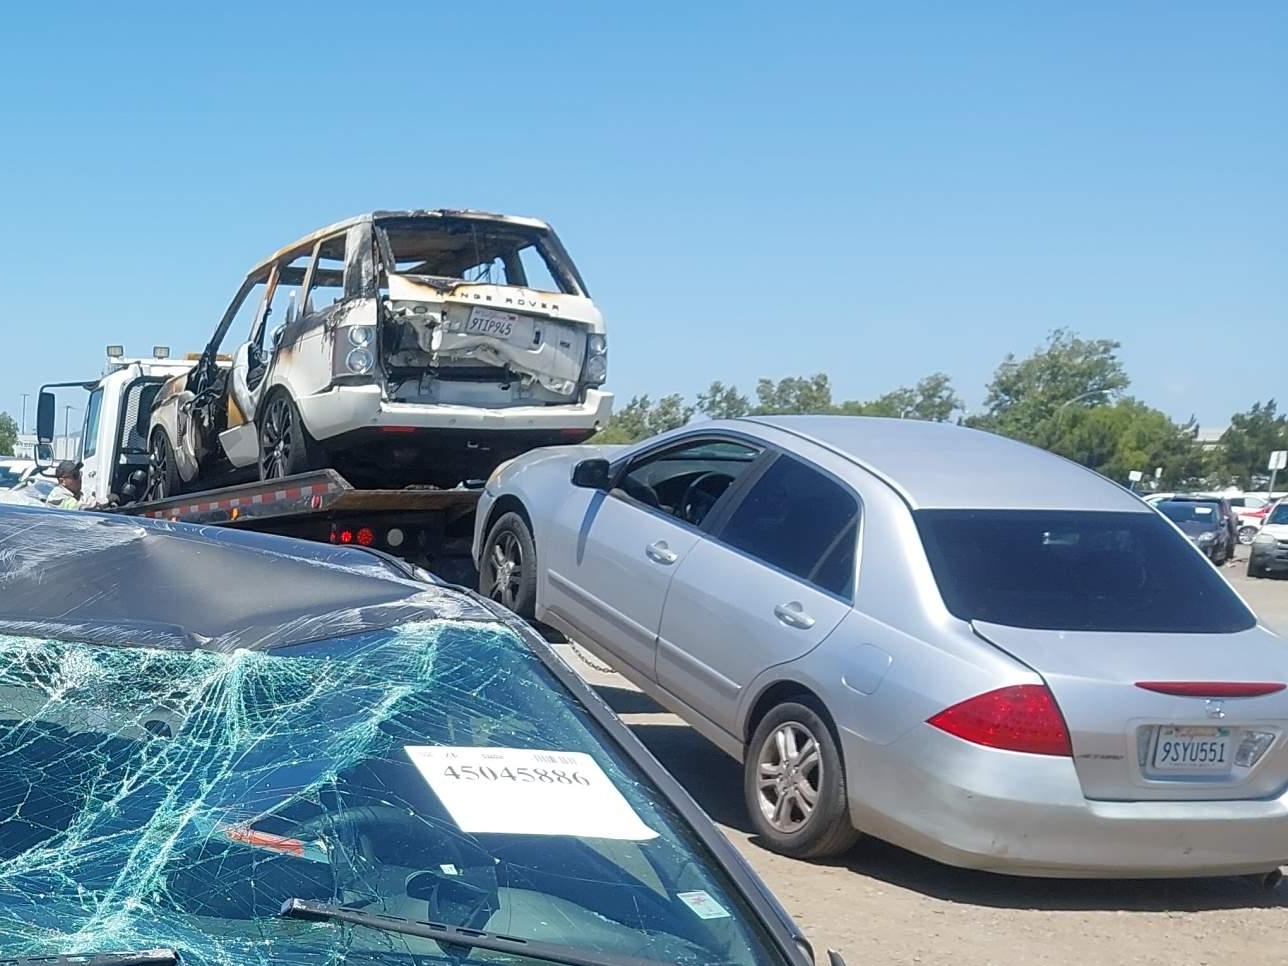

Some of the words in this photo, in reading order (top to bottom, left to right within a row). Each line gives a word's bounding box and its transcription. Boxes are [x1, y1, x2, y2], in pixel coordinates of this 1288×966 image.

[436, 289, 492, 301] RANGE
[504, 297, 559, 312] ROVER
[1161, 741, 1225, 762] 9SYU551
[443, 765, 592, 787] 45045886
